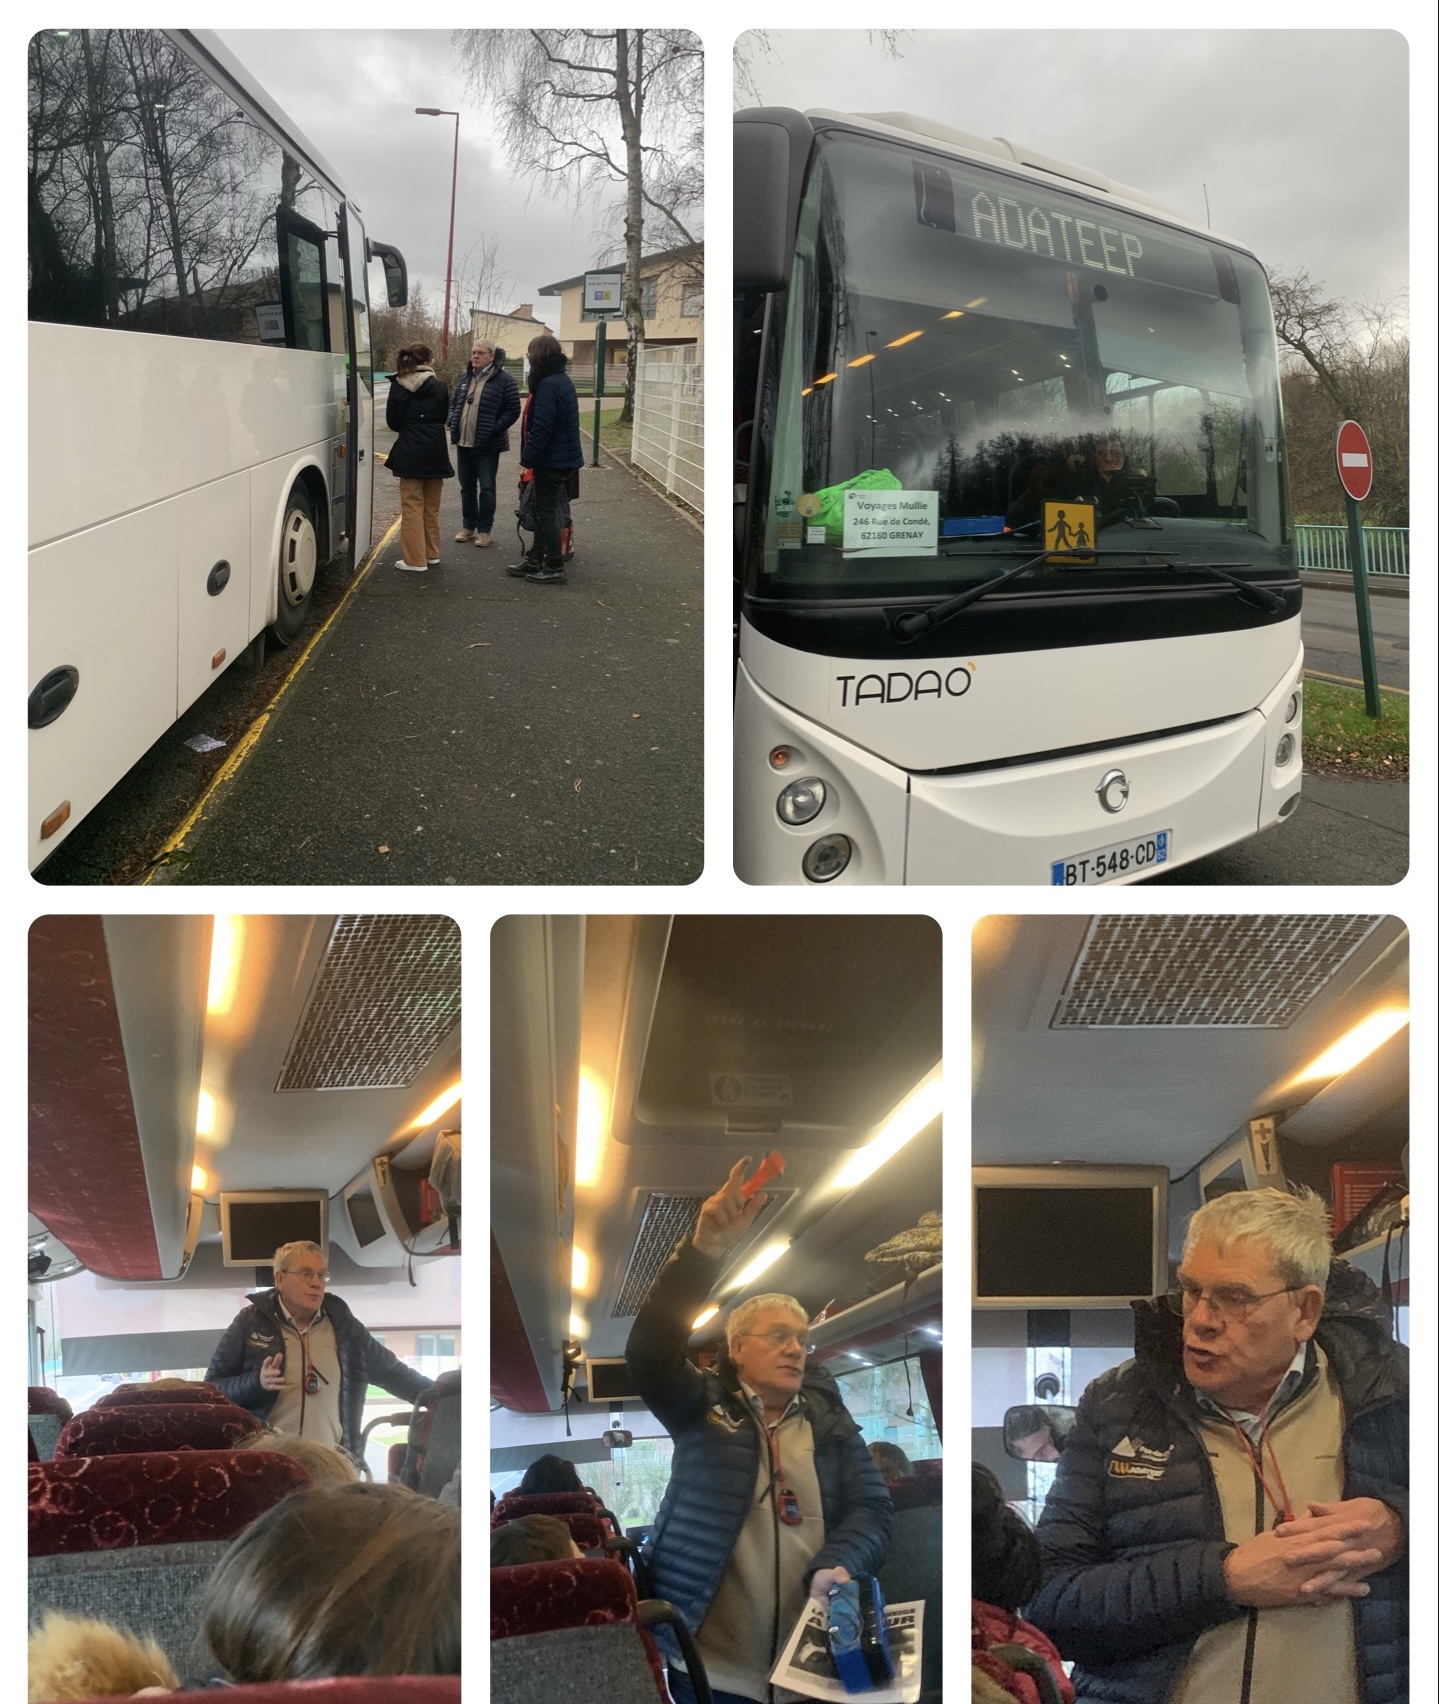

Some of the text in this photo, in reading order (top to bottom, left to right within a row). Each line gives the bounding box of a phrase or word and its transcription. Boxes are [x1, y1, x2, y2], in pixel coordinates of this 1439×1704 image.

[971, 191, 1143, 276] ADATEEP
[857, 501, 928, 511] Voyages Mullie
[853, 517, 931, 526] 246 Rue de Condé,
[860, 531, 923, 539] 62160 GRENAY
[836, 666, 972, 707] TADAO
[1065, 840, 1156, 886] BT-548-CD
